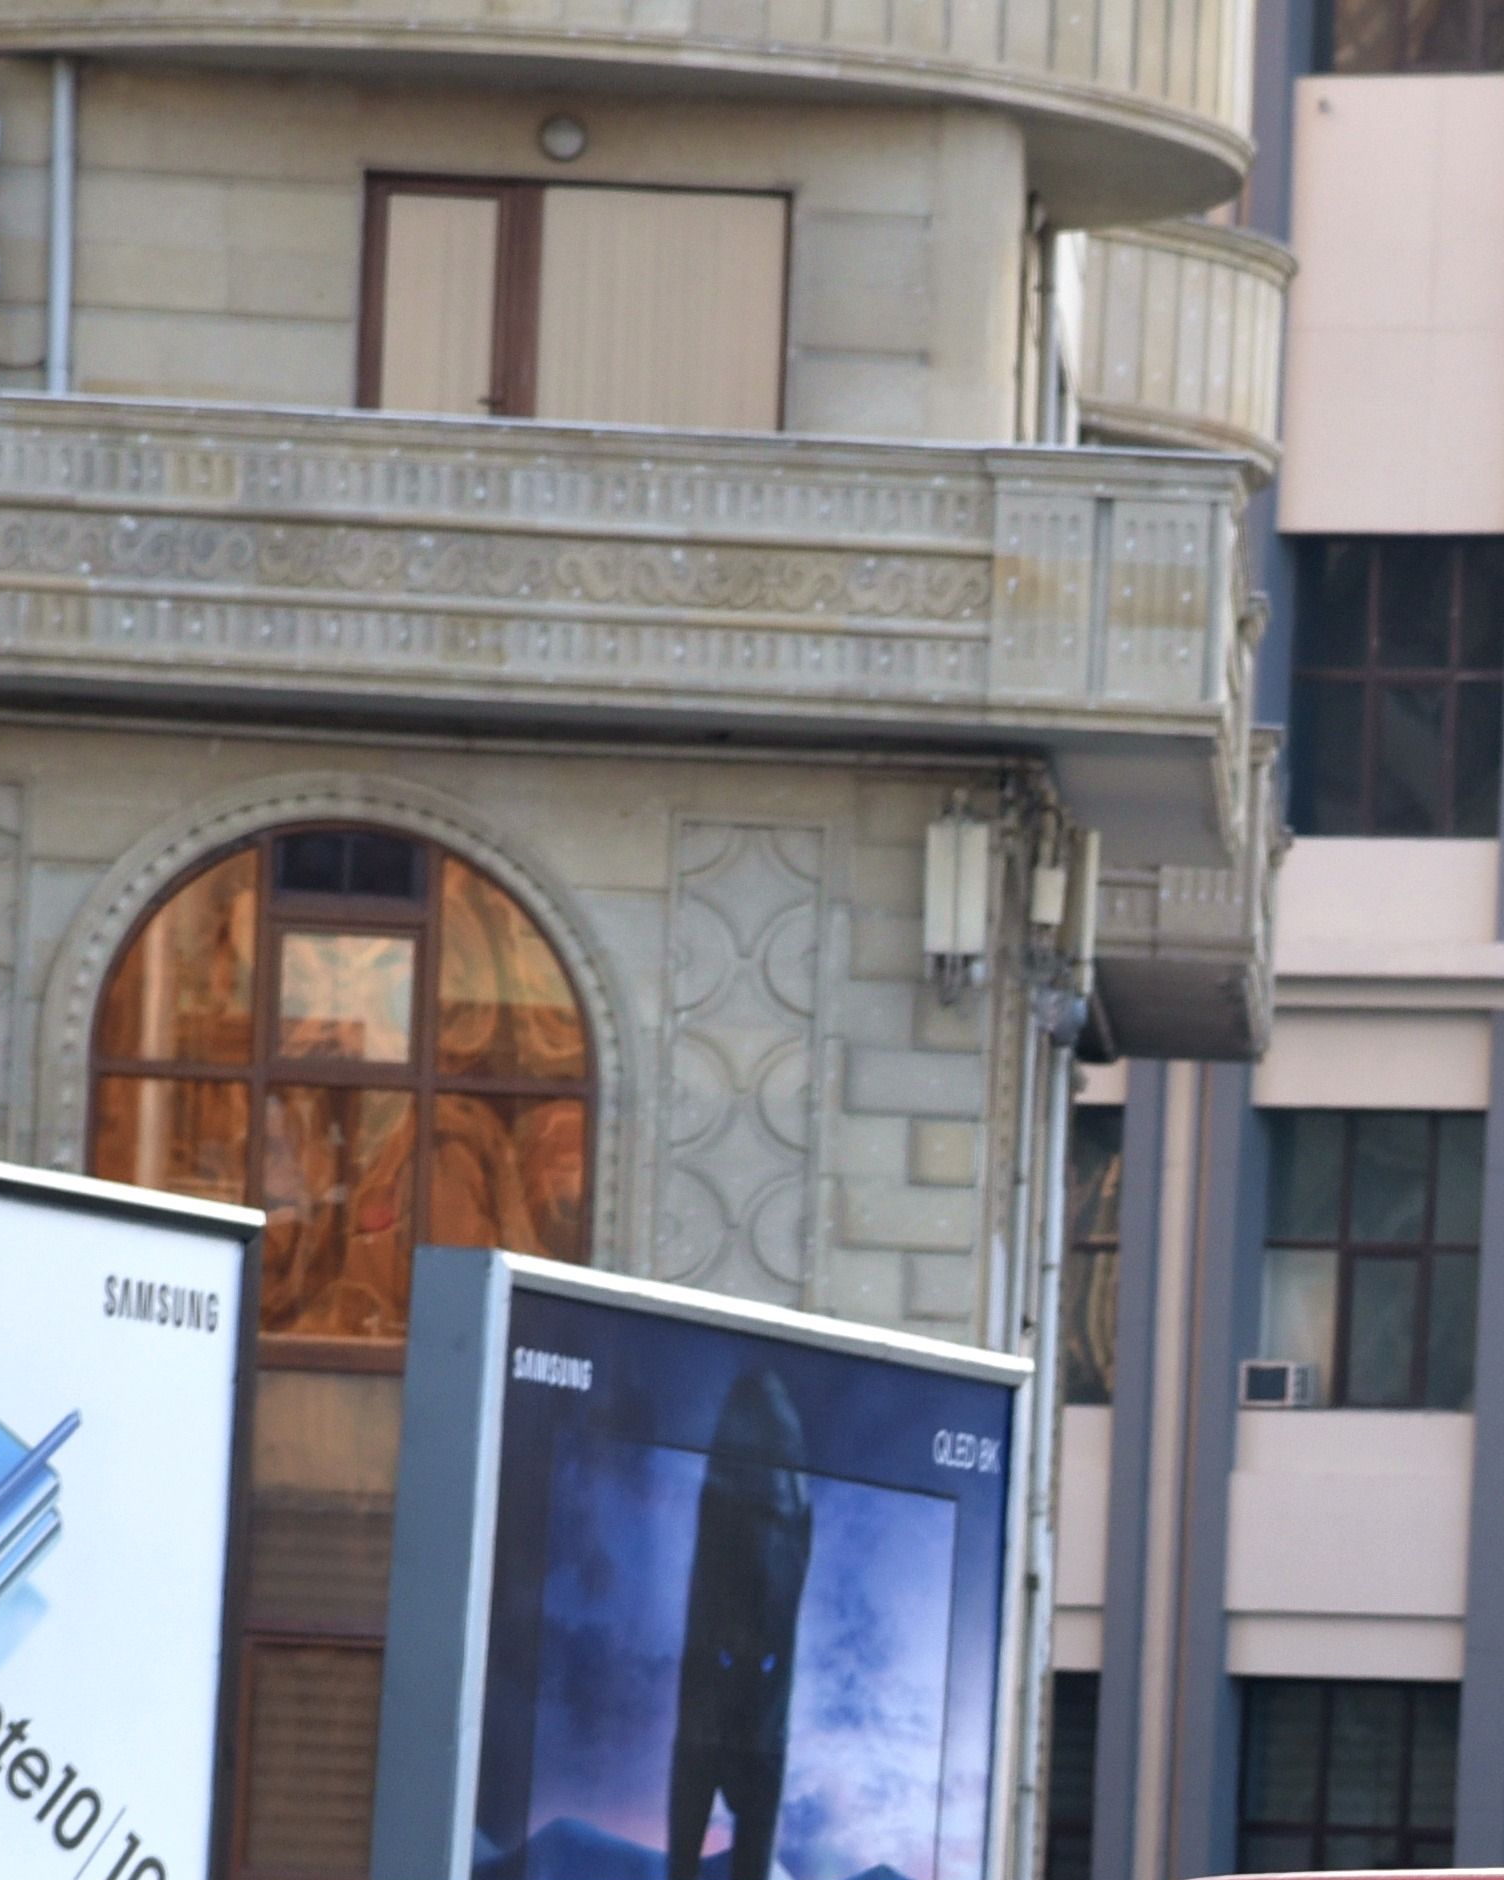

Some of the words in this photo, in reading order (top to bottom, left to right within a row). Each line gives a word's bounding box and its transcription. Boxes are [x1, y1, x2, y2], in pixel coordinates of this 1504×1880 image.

[104, 1275, 219, 1333] SAMSUNG
[513, 1346, 593, 1392] SAMSUNG
[934, 1429, 976, 1470] QLED
